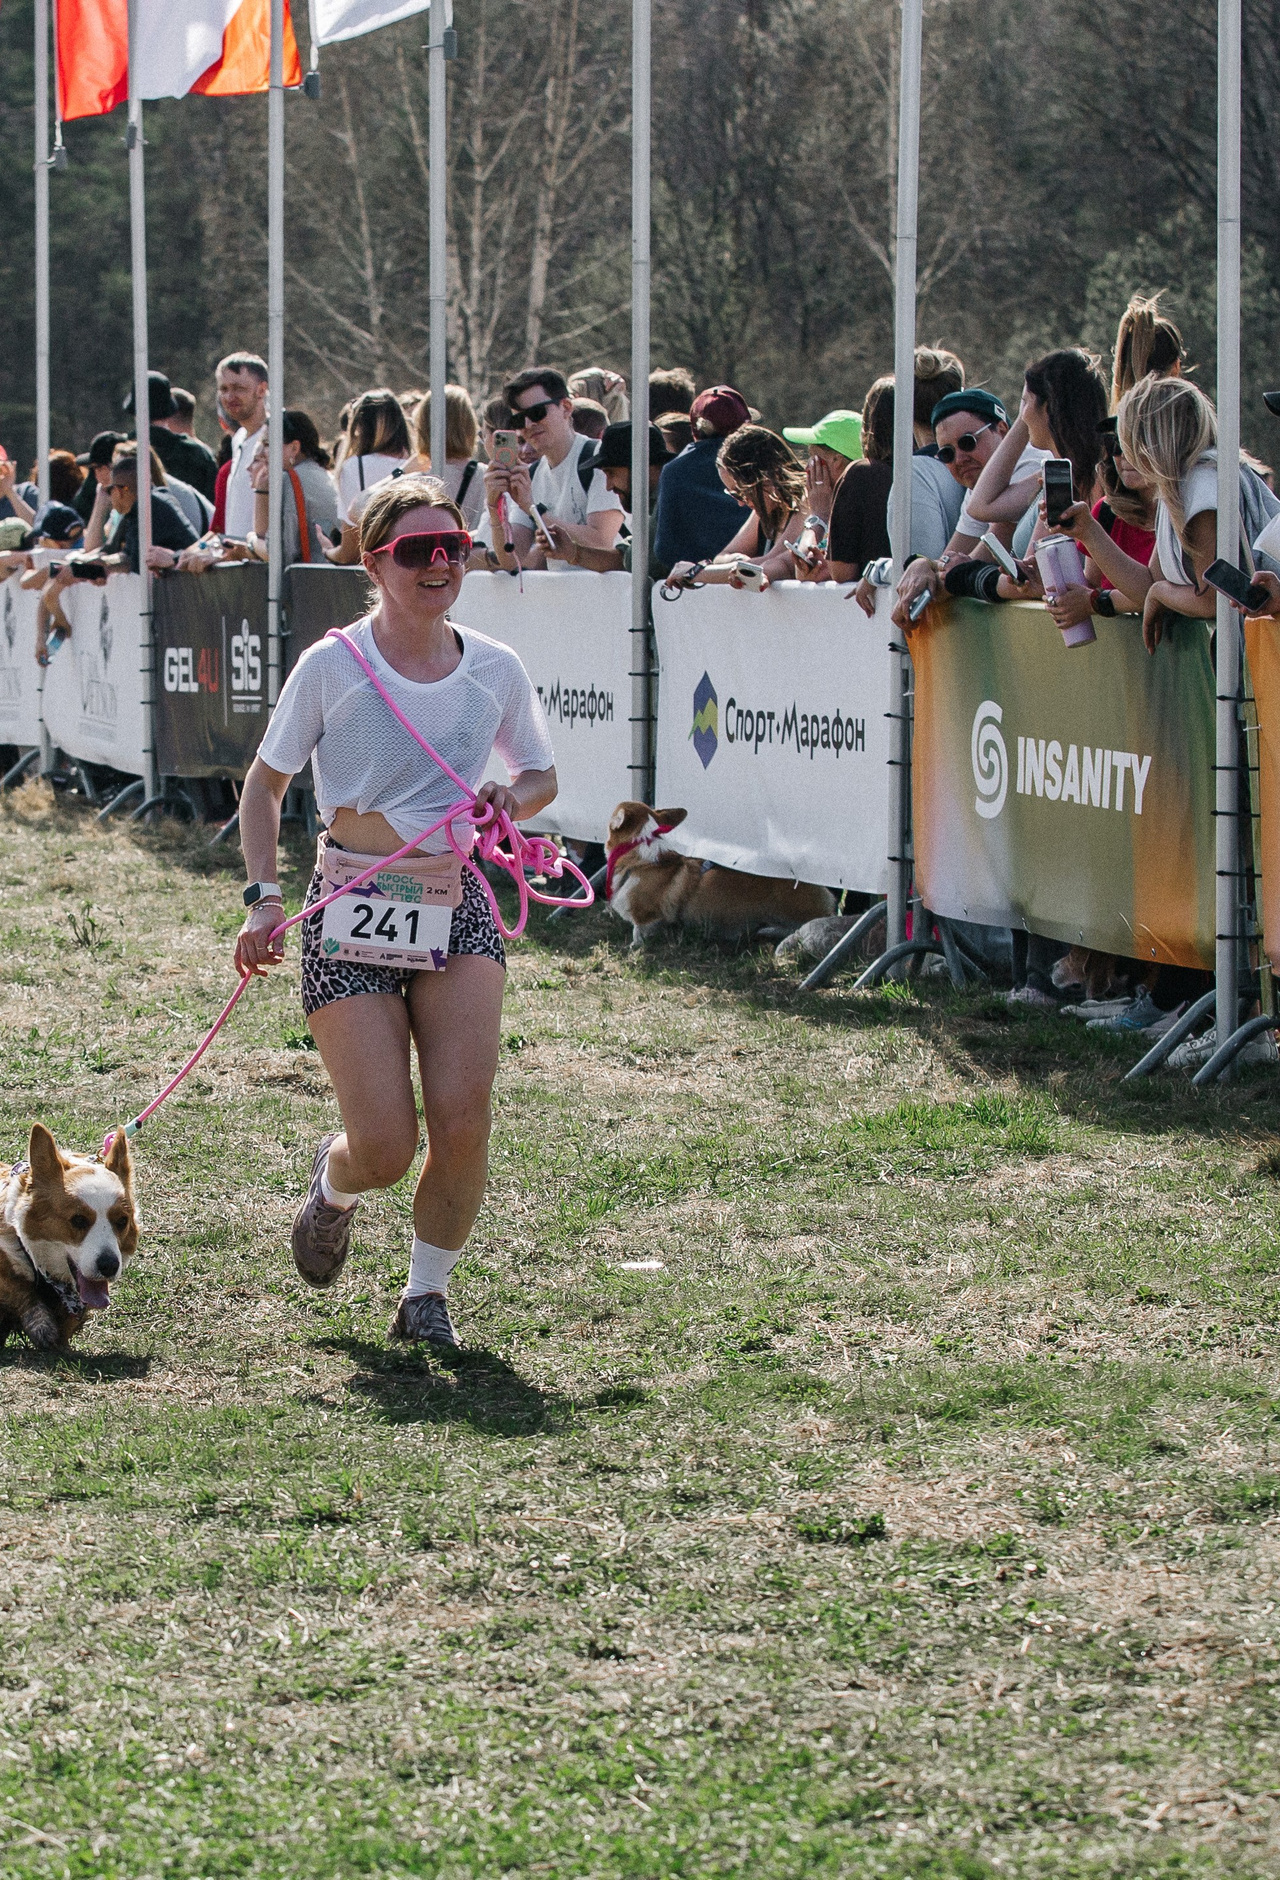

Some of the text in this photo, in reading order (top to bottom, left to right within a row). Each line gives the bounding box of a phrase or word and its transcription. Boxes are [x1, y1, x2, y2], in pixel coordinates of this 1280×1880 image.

[1016, 736, 1152, 815] INSANITY
[426, 886, 433, 894] 2
[350, 903, 420, 944] 241
